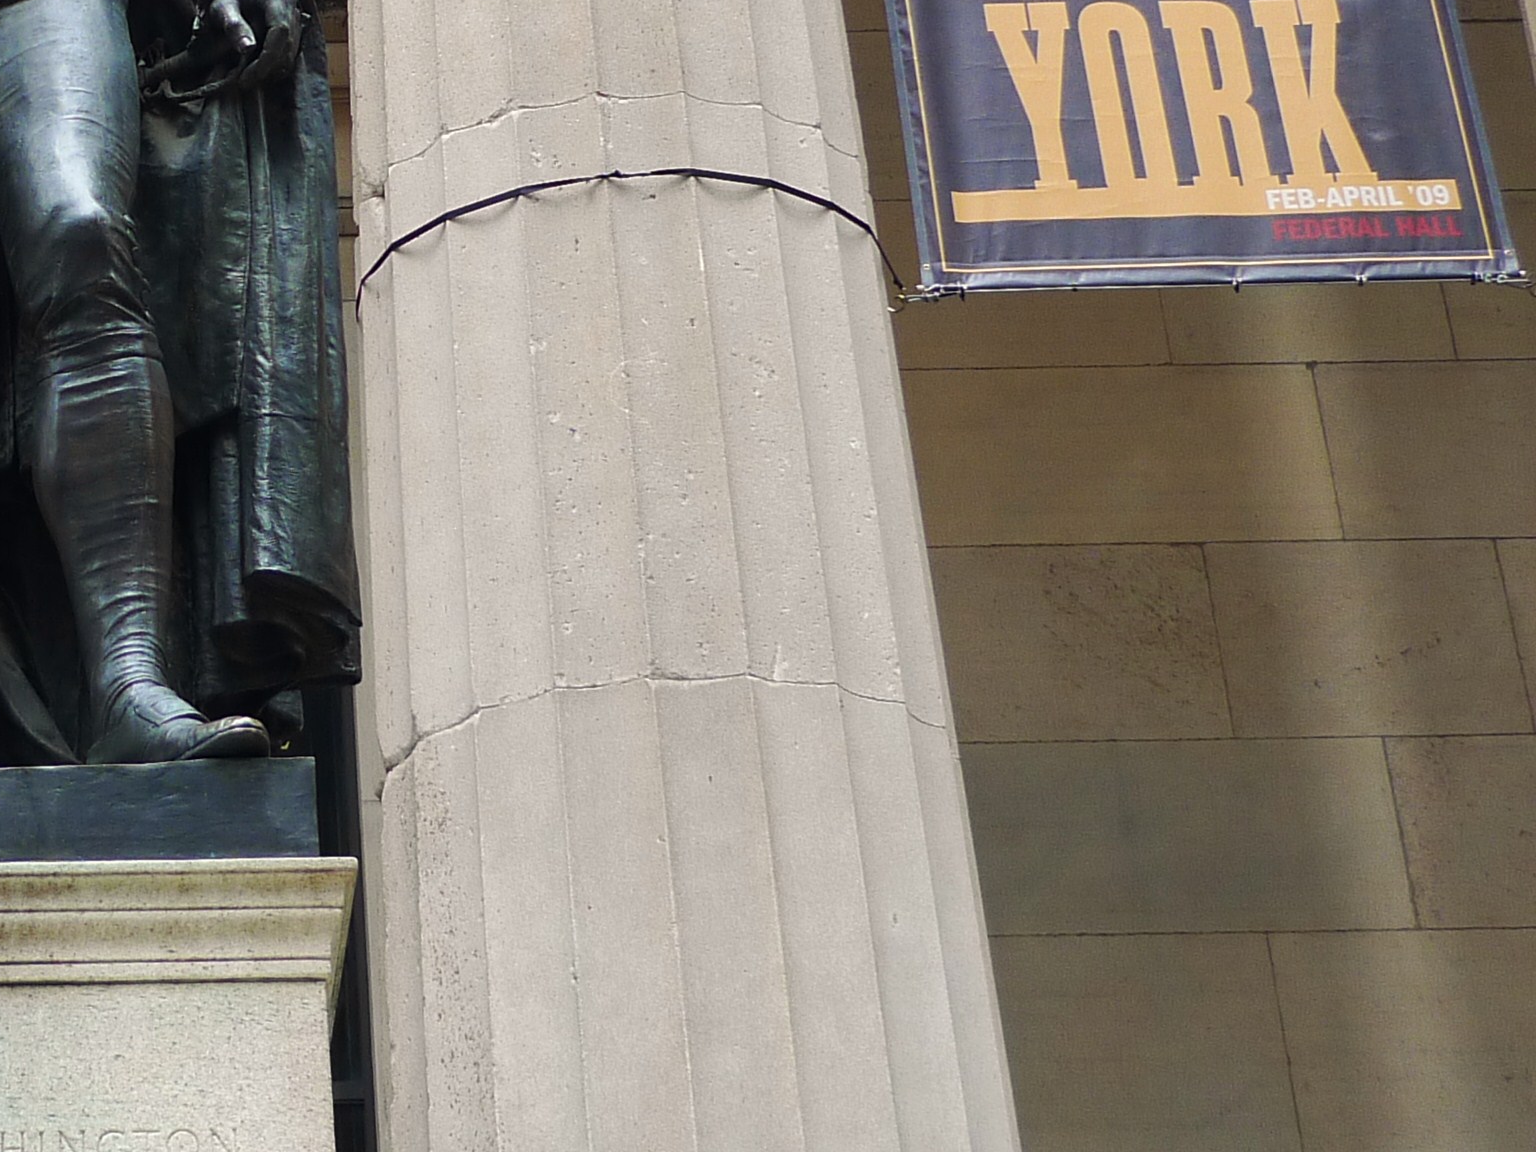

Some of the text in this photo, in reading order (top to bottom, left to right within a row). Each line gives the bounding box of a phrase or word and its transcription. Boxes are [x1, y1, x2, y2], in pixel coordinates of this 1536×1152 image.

[1265, 184, 1450, 210] FEB-APRIL '09
[1271, 215, 1463, 241] FEDERAL HALL
